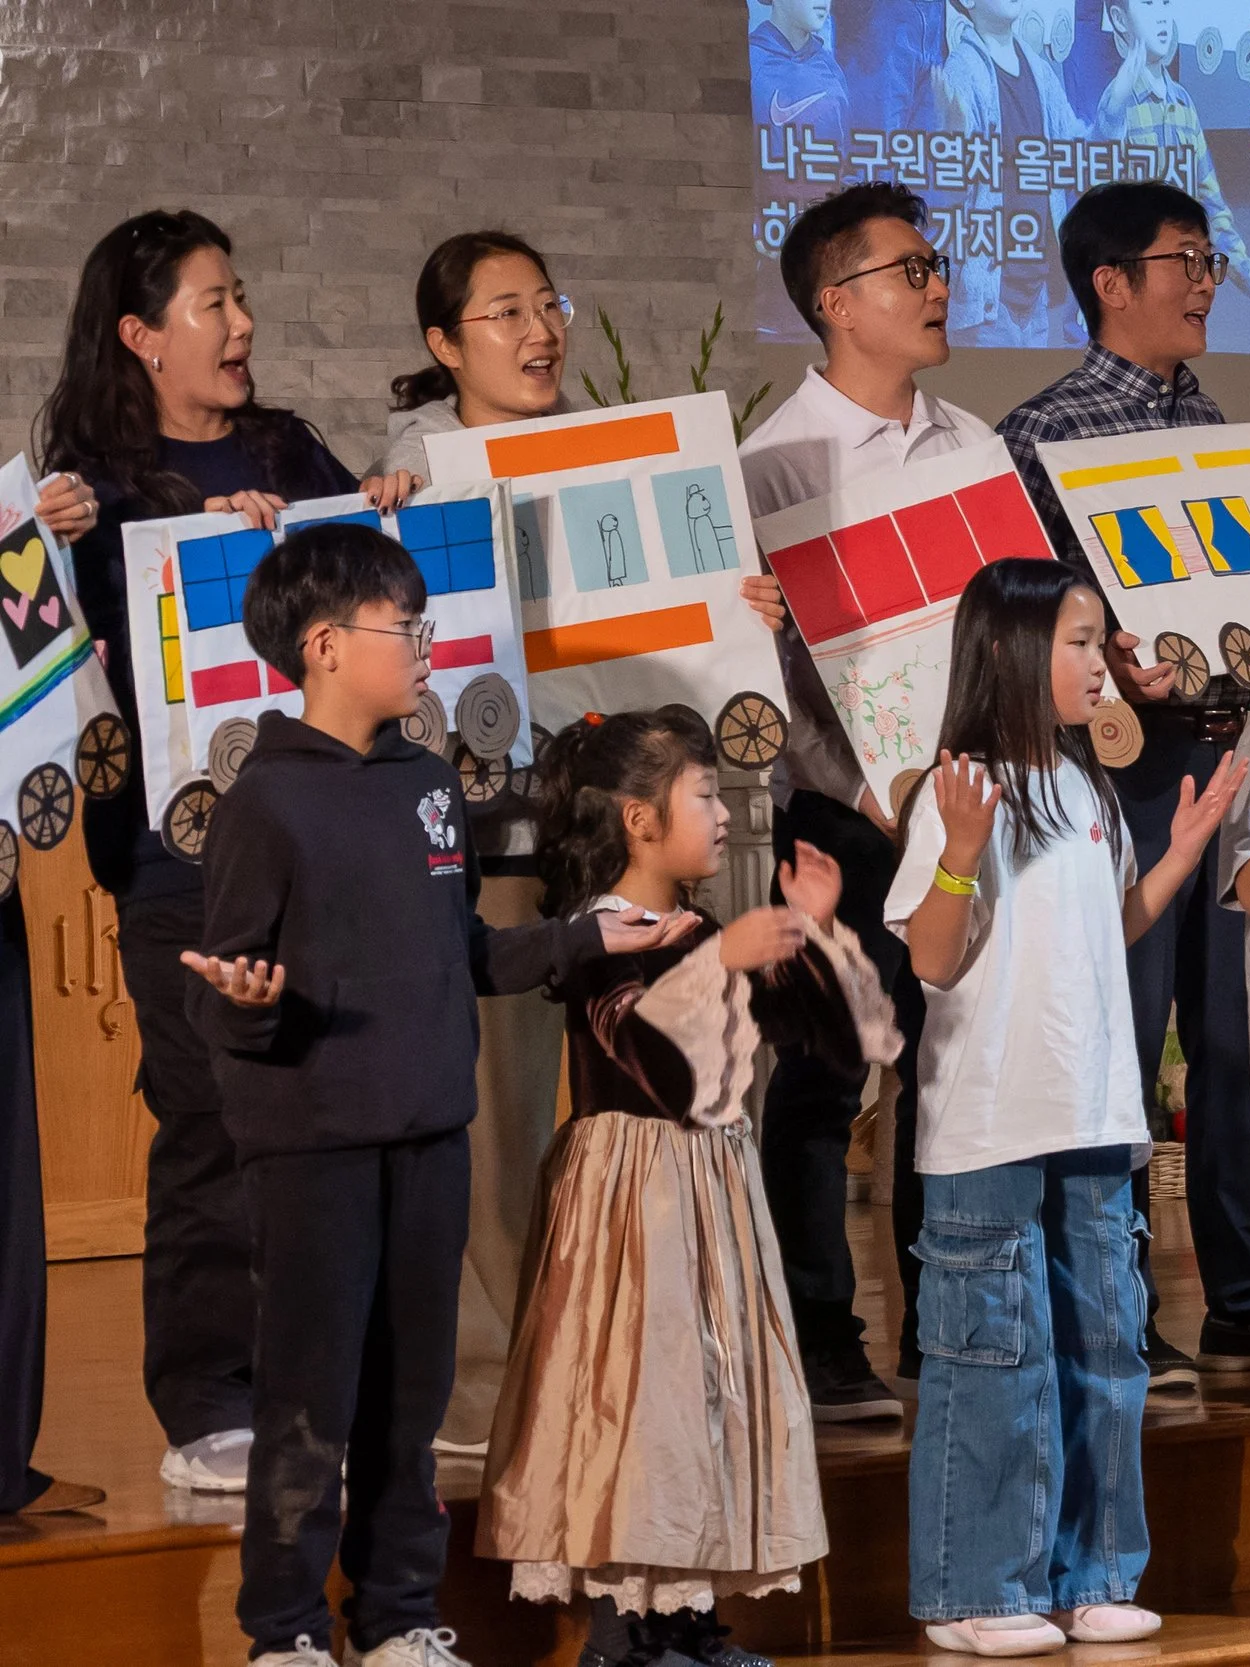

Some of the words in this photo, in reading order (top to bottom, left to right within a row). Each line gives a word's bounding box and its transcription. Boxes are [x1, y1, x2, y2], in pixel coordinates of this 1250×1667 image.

[760, 127, 839, 180] 나는
[851, 133, 1003, 188] 구원열차
[932, 208, 1044, 261] 가지요
